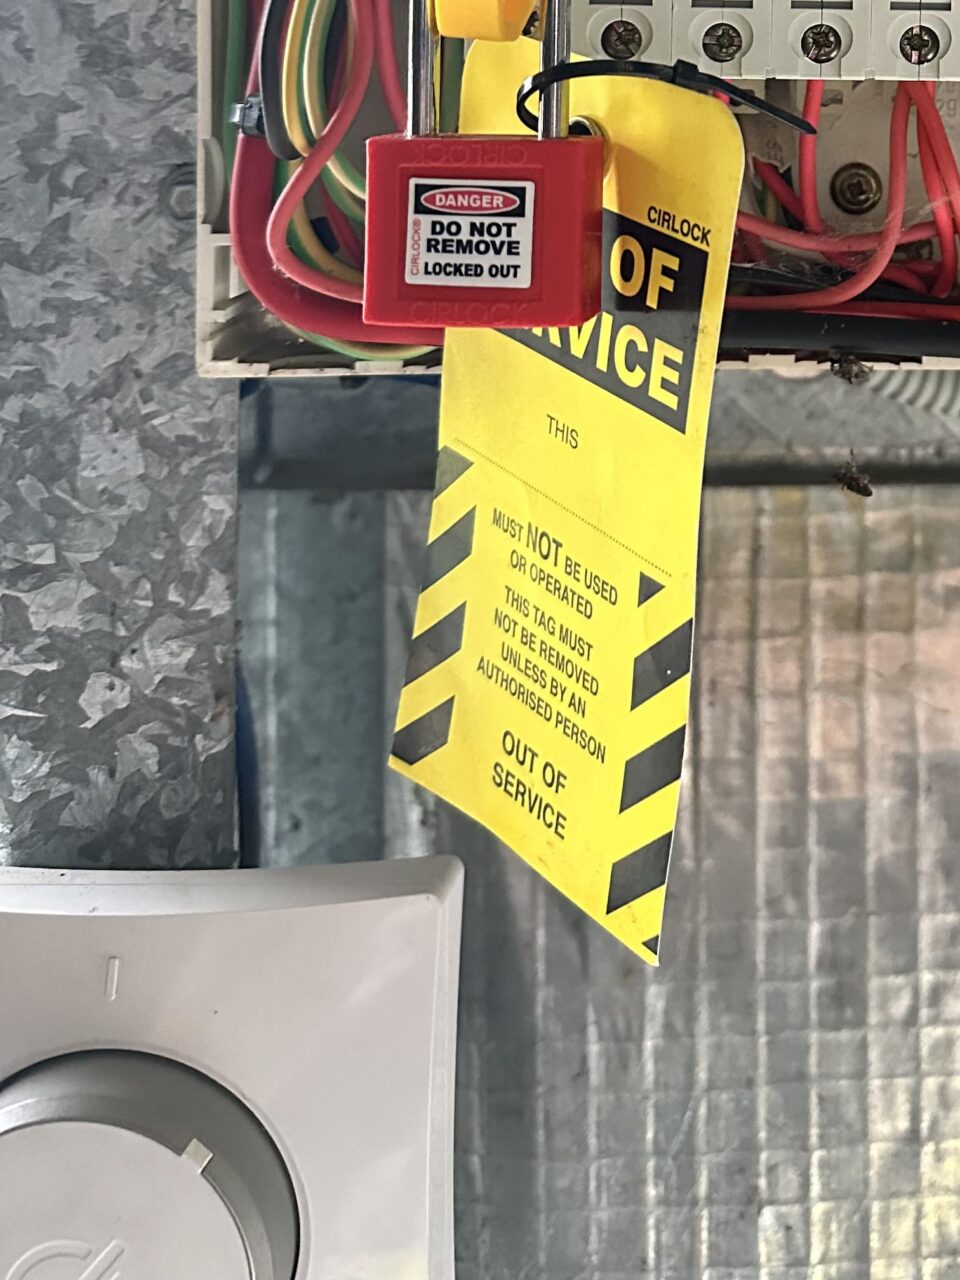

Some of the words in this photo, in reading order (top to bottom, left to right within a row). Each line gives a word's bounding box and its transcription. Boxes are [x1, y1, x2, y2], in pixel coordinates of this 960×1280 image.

[430, 221, 461, 236] DO
[469, 222, 517, 238] NOT
[435, 194, 504, 208] DANGER
[647, 206, 712, 247] CIRLOCK
[424, 262, 484, 277] LOCKED
[489, 264, 520, 278] OUT
[426, 239, 520, 256] REMOVE
[610, 234, 680, 310] OF
[532, 311, 684, 411] VICE
[546, 414, 579, 449] THIS
[493, 507, 524, 542] MUST
[526, 521, 563, 567] NOT
[565, 555, 581, 583] BE
[584, 568, 618, 606] USED
[510, 549, 527, 575] OR
[530, 563, 593, 620] OPERATED
[494, 608, 518, 638] NOT
[520, 626, 537, 652] BE
[539, 639, 599, 696] REMOVED
[505, 585, 529, 618] THIS
[533, 605, 556, 637] TAG
[559, 624, 594, 662] MUST
[476, 655, 553, 722] AUTHORISED
[555, 711, 606, 764] PERSON
[501, 641, 547, 689] UNLESS
[550, 677, 567, 702] BY
[568, 692, 586, 718] AN
[502, 730, 539, 773] OUT
[542, 761, 567, 794] OF
[492, 761, 567, 840] SERVICE
